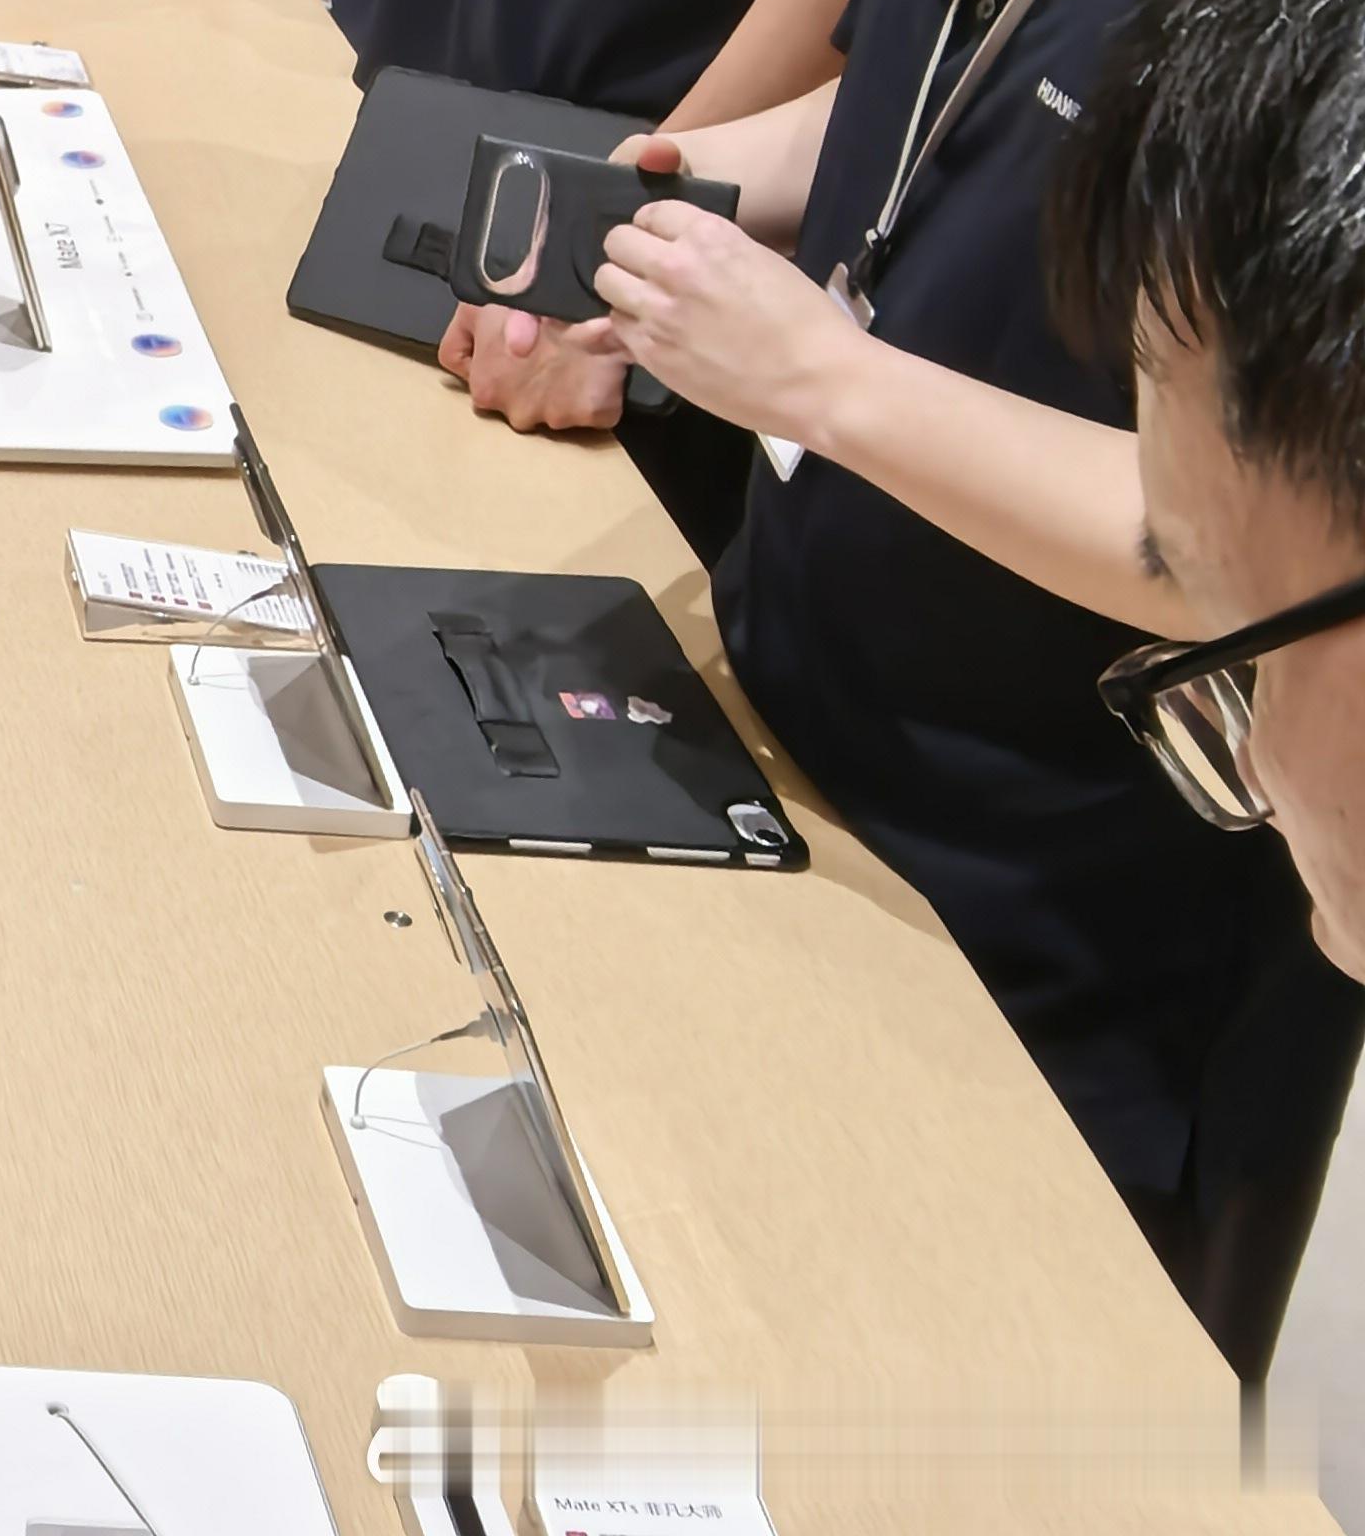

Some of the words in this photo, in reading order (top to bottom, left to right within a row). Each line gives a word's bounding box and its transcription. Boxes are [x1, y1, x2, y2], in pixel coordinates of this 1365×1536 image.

[554, 1497, 601, 1512] Mate
[645, 1502, 724, 1519] 非凡大师
